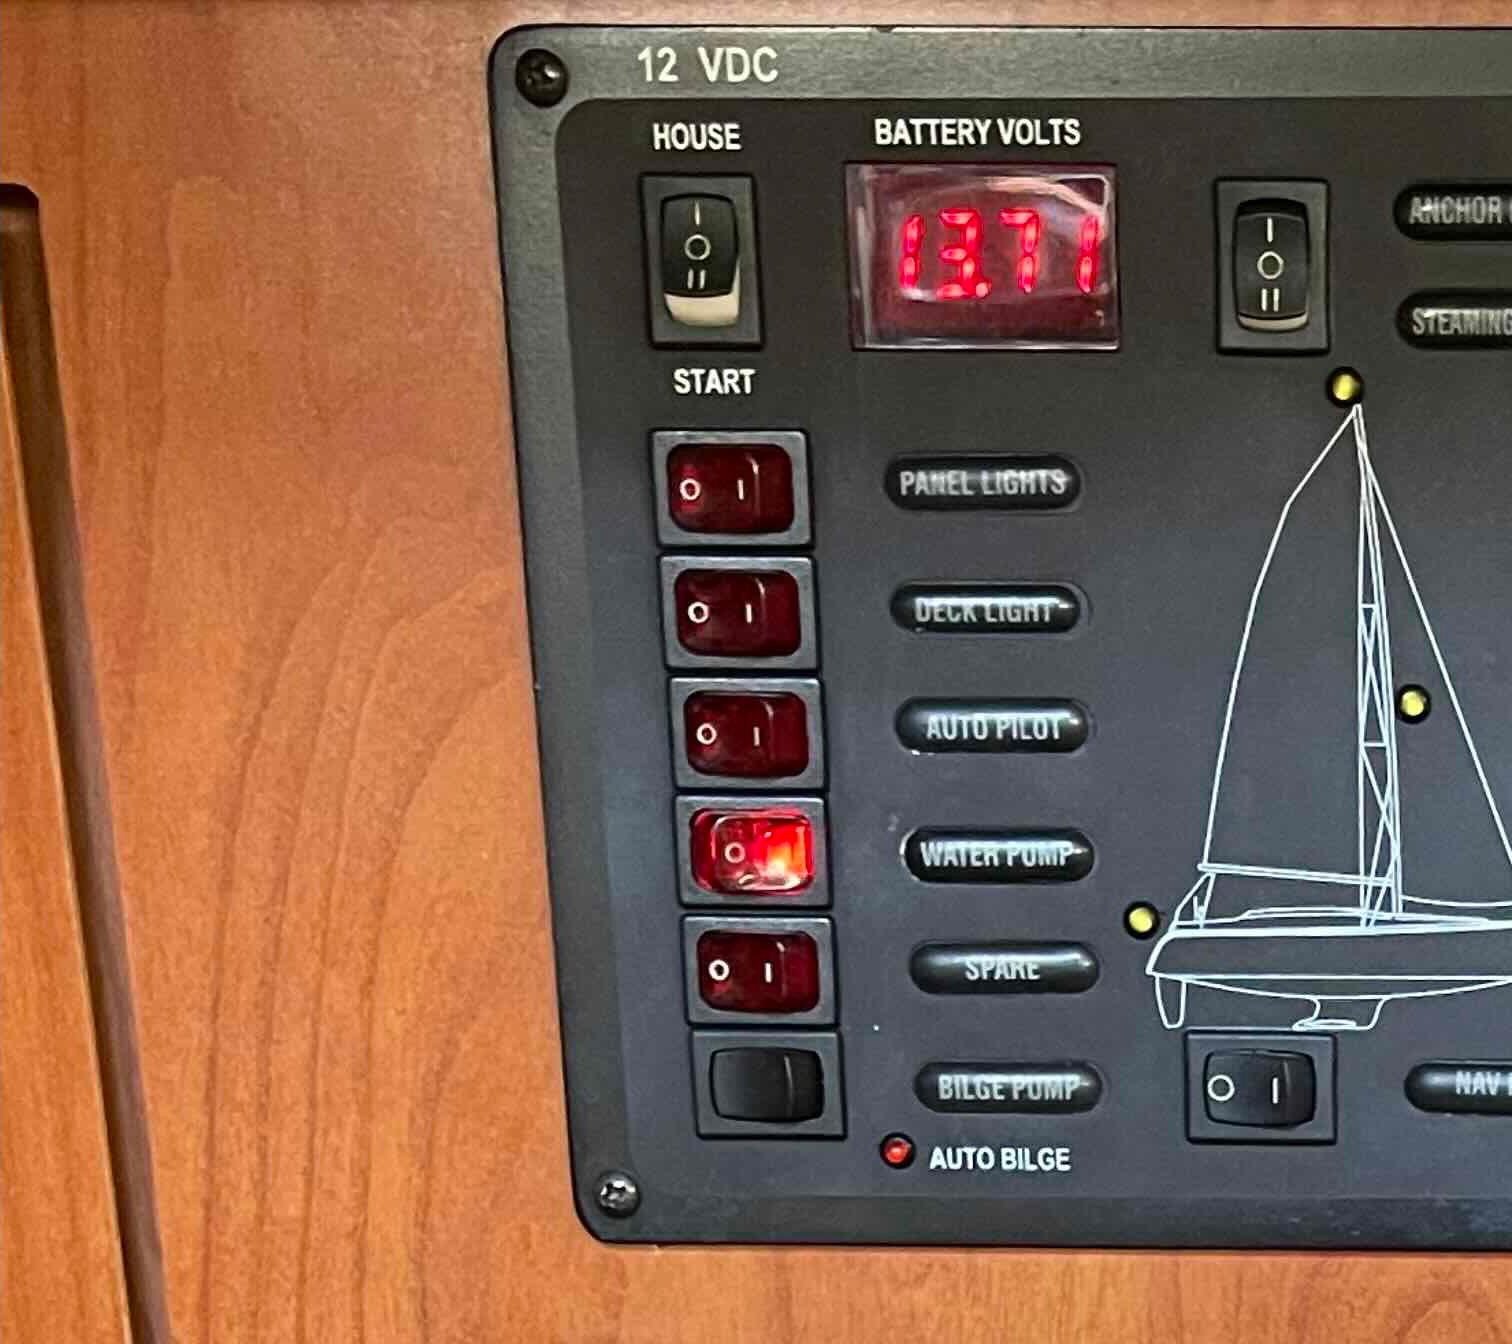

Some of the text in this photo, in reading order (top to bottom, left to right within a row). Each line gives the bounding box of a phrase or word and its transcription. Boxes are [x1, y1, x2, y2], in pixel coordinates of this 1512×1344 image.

[638, 48, 778, 82] 12 VDC
[653, 123, 740, 150] HOUSE
[875, 118, 1080, 146] BATTERY VOLTS
[1410, 197, 1501, 224] ANCHOR
[674, 368, 755, 395] START
[901, 469, 1066, 495] PANEL LIGHTS
[915, 598, 1051, 623] DECK LIGHT
[926, 714, 1064, 740] AUTO PILOT
[921, 842, 1073, 866] WATER PUMP
[965, 960, 1040, 981] SPARE
[939, 1076, 1080, 1101] BILGE PUMP
[1456, 1072, 1500, 1094] NAV
[930, 1147, 1070, 1171] AUTO BILGE
